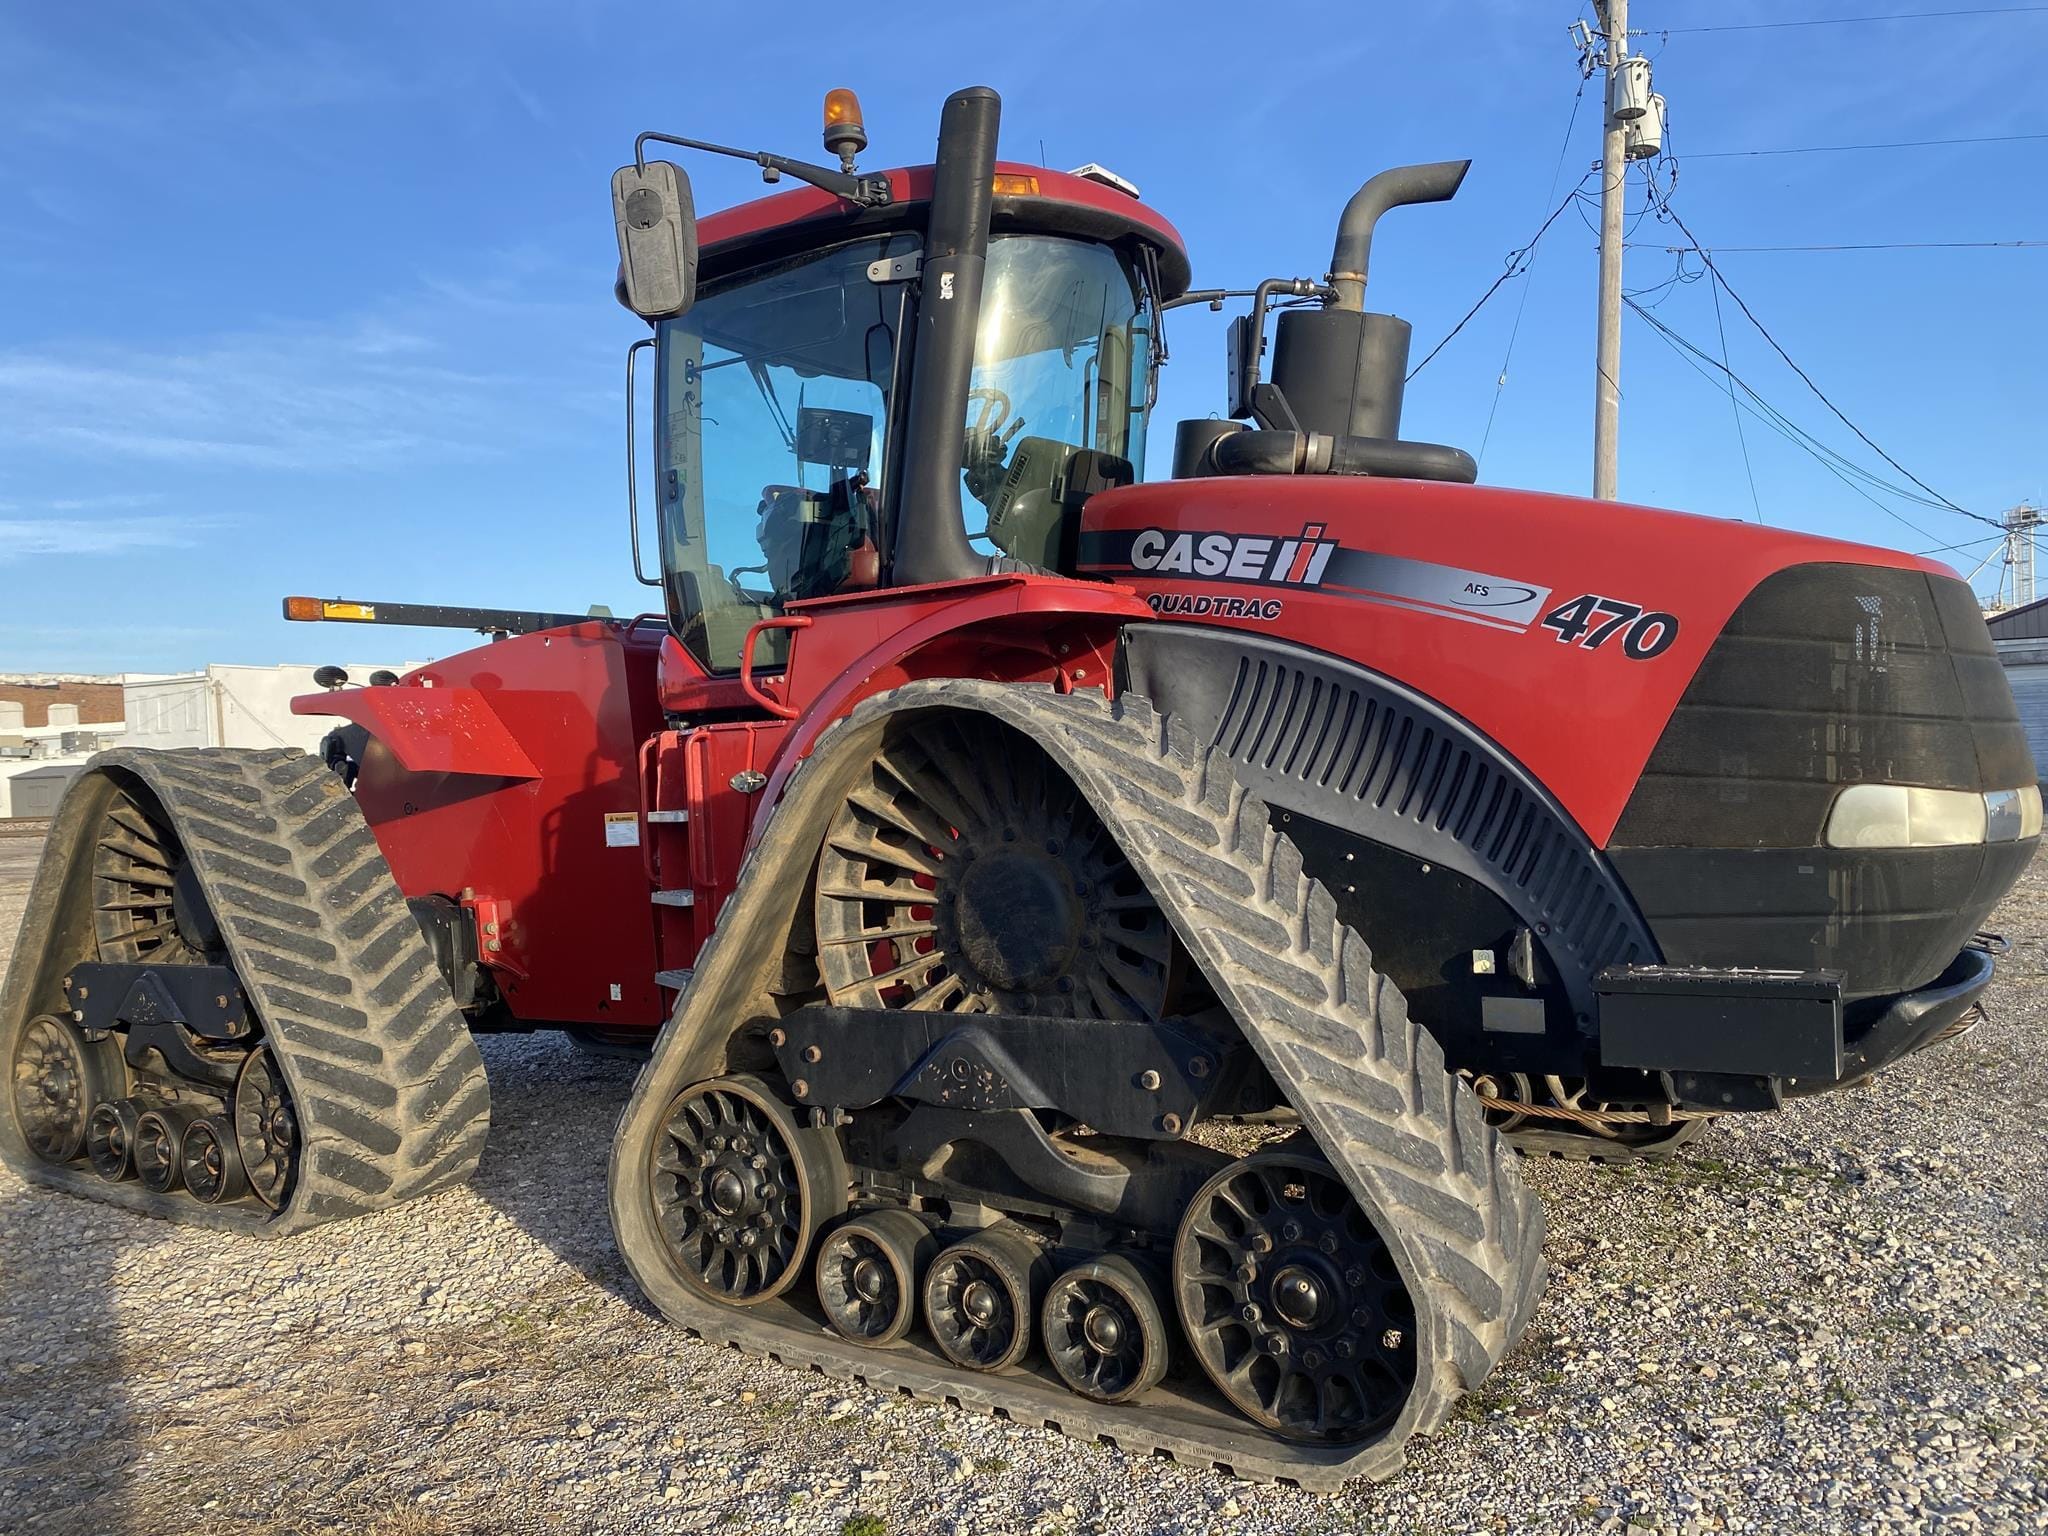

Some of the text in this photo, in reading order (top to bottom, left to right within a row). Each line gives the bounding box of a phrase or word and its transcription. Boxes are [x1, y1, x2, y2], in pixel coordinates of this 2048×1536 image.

[1131, 529, 1273, 580] CASE
[1147, 592, 1283, 620] QUADTRAC
[1463, 582, 1490, 597] AFS
[1540, 593, 1680, 661] 470
